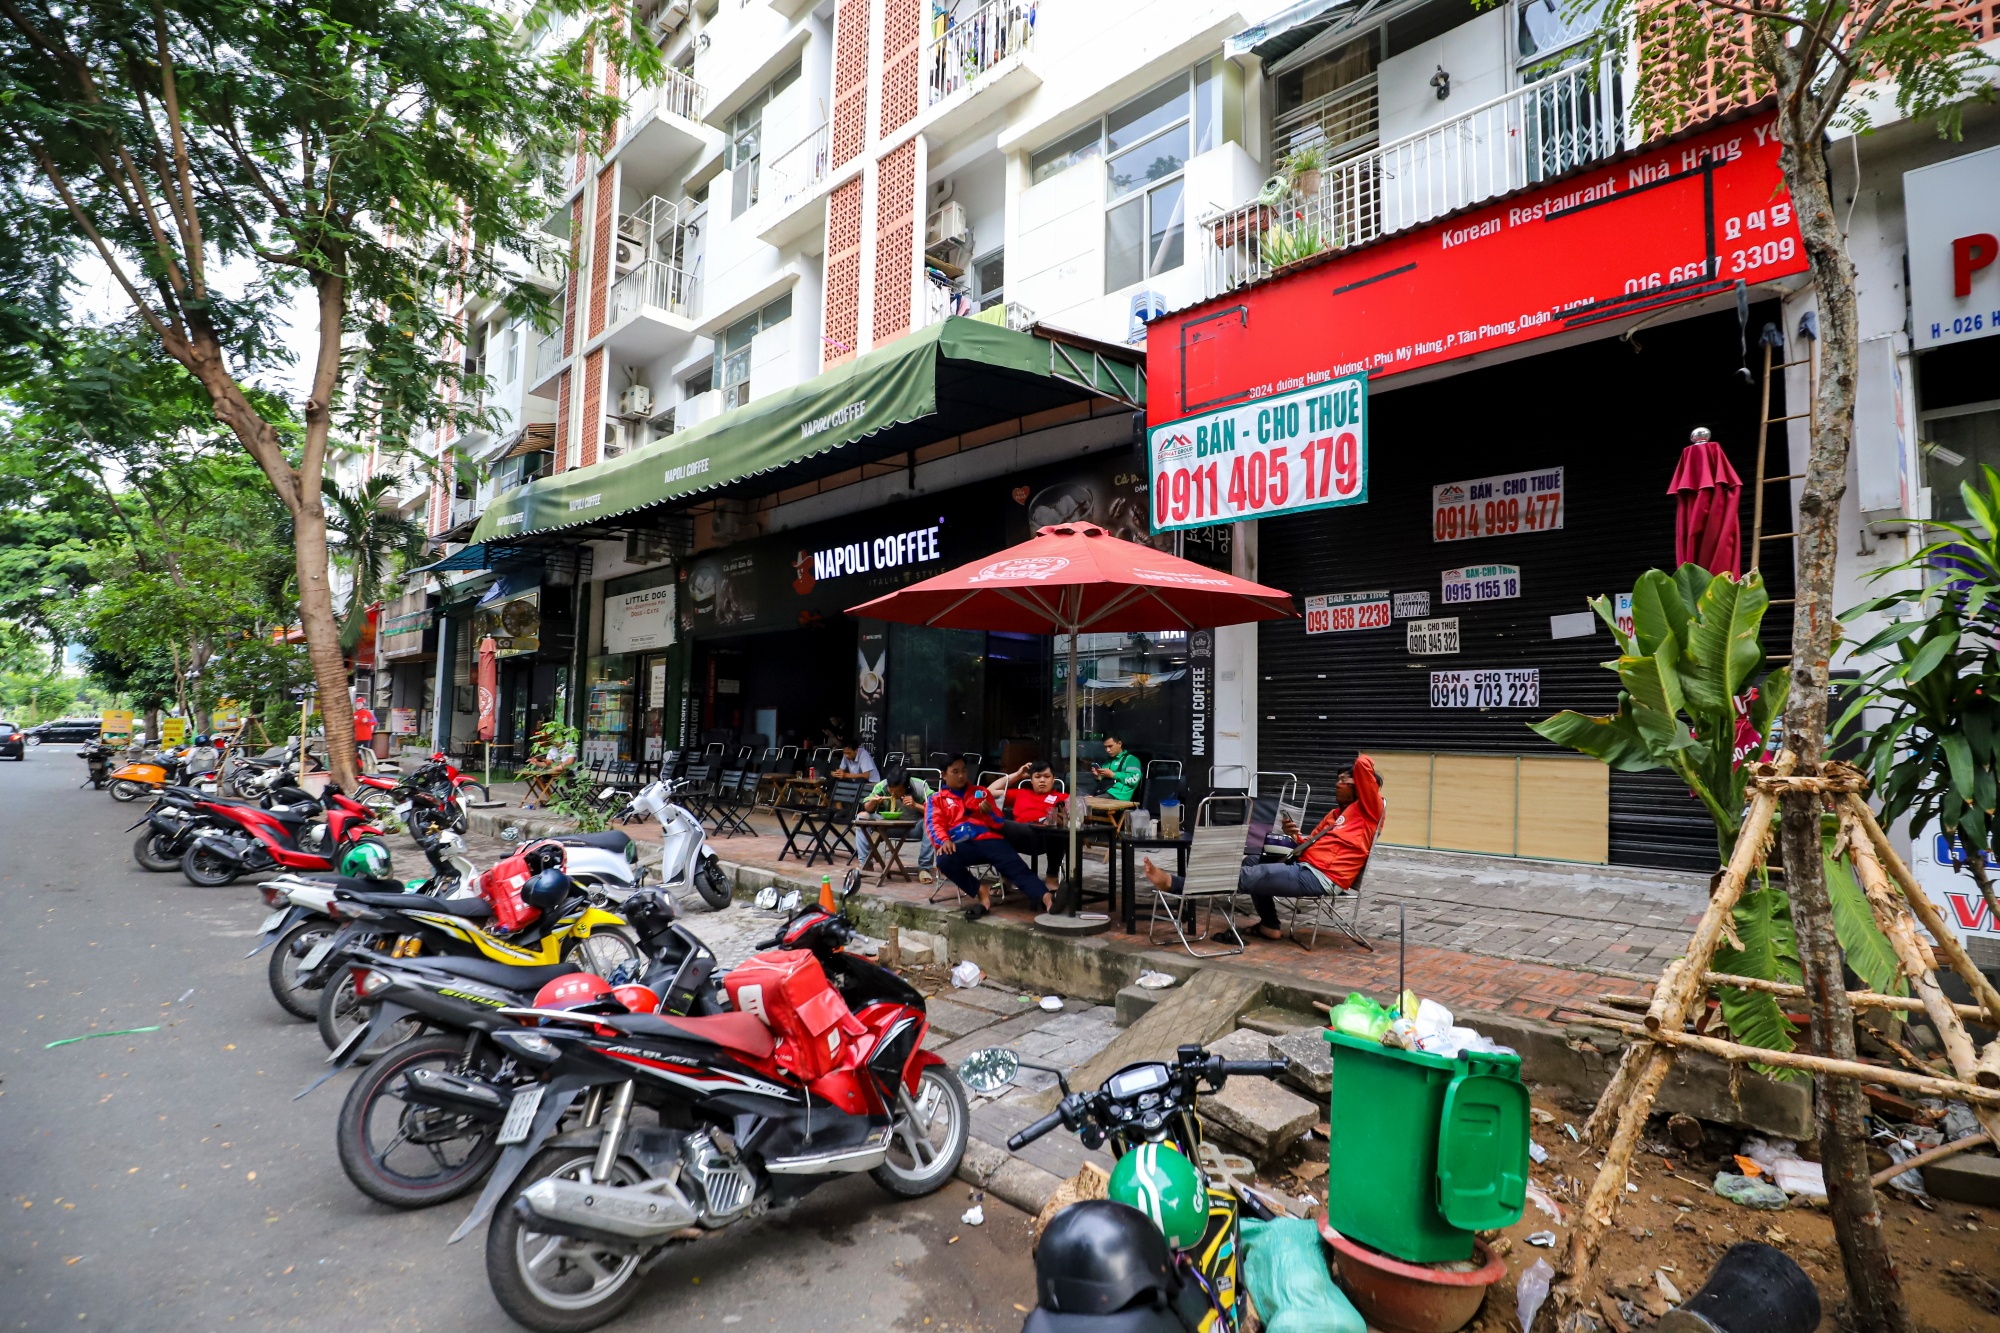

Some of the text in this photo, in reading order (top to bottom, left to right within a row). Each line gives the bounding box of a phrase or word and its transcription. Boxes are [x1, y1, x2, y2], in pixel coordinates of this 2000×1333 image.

[1442, 217, 1501, 250] Korean
[1509, 177, 1617, 228] Restaurant
[1724, 202, 1792, 241] 요식당
[1731, 237, 1796, 273] 3309
[1307, 369, 1331, 384] Hưng
[801, 399, 866, 439] NAPOLI COFFEE
[1196, 417, 1235, 458] BÁN
[1257, 402, 1300, 445] CHO
[1306, 381, 1359, 433] THUÊ
[664, 457, 709, 483] NAPOLI COFFEE
[1156, 432, 1358, 525] 0911 405 179
[1470, 481, 1492, 500] BÁN
[1503, 478, 1527, 496] CHO
[1531, 470, 1560, 492] THUÊ
[1436, 492, 1560, 540] 0914 999 477
[814, 526, 940, 581] NAPOLI COFFEE
[625, 591, 667, 605] LITTLE DOG
[1445, 578, 1517, 601] 0915 1155 18
[1307, 603, 1389, 632] 093 858 2238
[1427, 622, 1440, 631] CHO
[1410, 631, 1458, 653] 0906 945 322
[1192, 667, 1206, 711] COFFEE
[1432, 672, 1461, 684] BÁN
[1474, 673, 1501, 683] CHO
[1505, 669, 1539, 683] THUÊ
[1431, 683, 1538, 707] 0919 703 223
[1192, 713, 1205, 756] NAPOLI
